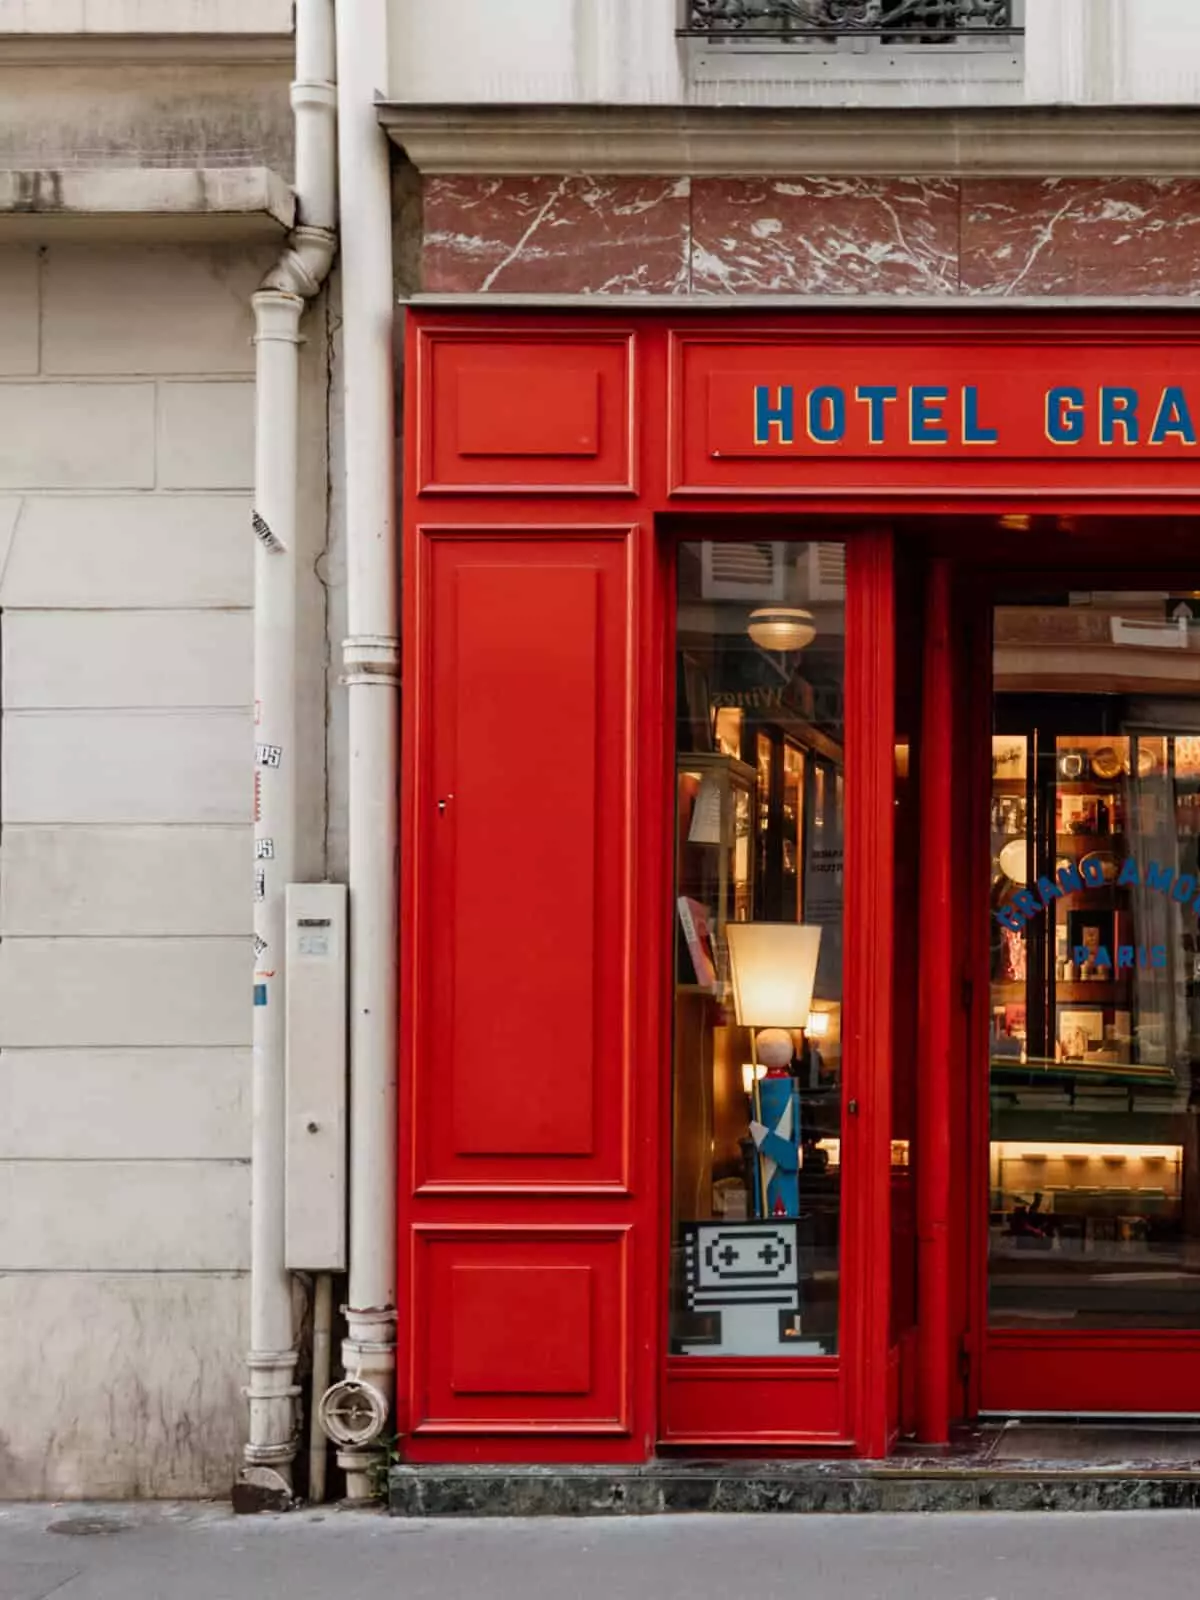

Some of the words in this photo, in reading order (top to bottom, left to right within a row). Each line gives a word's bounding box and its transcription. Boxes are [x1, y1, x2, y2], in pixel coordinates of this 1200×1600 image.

[753, 385, 998, 445] HOTEL
[996, 857, 1106, 933] GRAND
[1073, 945, 1167, 969] PARIS
